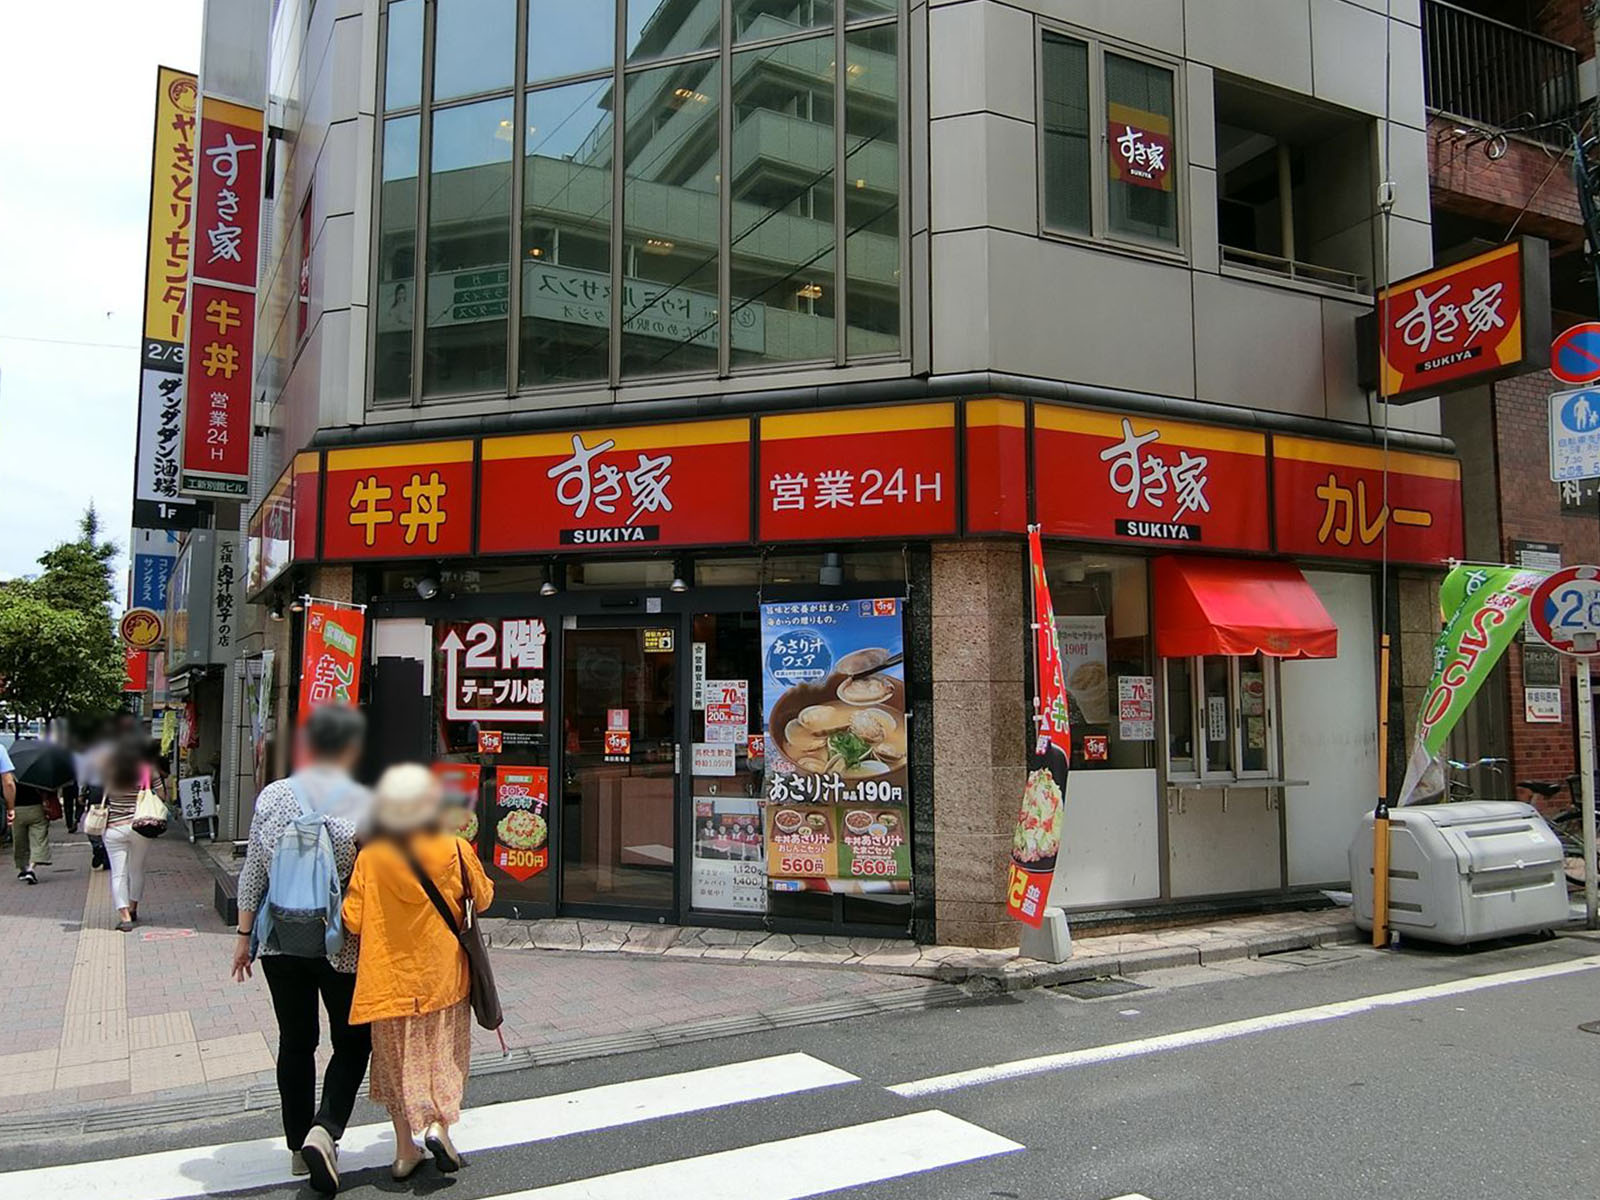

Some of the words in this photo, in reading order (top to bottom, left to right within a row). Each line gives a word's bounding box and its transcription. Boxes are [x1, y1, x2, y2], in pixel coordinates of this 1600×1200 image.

[1116, 126, 1165, 172] すき家
[205, 132, 256, 264] すき家
[162, 113, 196, 338] やきとりセンター
[1394, 282, 1506, 353] すき家
[201, 299, 242, 379] 牛丼
[1423, 349, 1473, 371] SUKIYA
[153, 378, 183, 498] ダンダダン酒場
[206, 391, 230, 461] 営業24H
[546, 433, 674, 526] すき家
[1099, 417, 1211, 523] すき家
[768, 467, 942, 512] 営業24H
[157, 503, 178, 519] 1F
[348, 471, 447, 546] 牛丼
[1316, 473, 1433, 546] カレー
[573, 527, 645, 544] SUKIYA
[1126, 520, 1190, 540] SUKIYA
[143, 557, 154, 601] サングラス
[158, 557, 169, 601] コンタクト
[216, 540, 234, 648] 元祖肉汁餃子の店
[465, 618, 547, 670] 2階
[773, 637, 824, 654] あさり汁
[781, 655, 817, 668] フェア
[461, 678, 545, 705] テーブル席
[769, 773, 845, 803] あさり汁
[857, 781, 902, 801] 190円
[774, 833, 831, 845] 牛丼あさり汁
[778, 844, 827, 854] おしんこセット
[844, 834, 902, 847] 牛丼あさり汁
[852, 845, 896, 856] たまごセット
[508, 850, 544, 868] 500円
[781, 857, 826, 874] 560円
[851, 858, 898, 876] 560円
